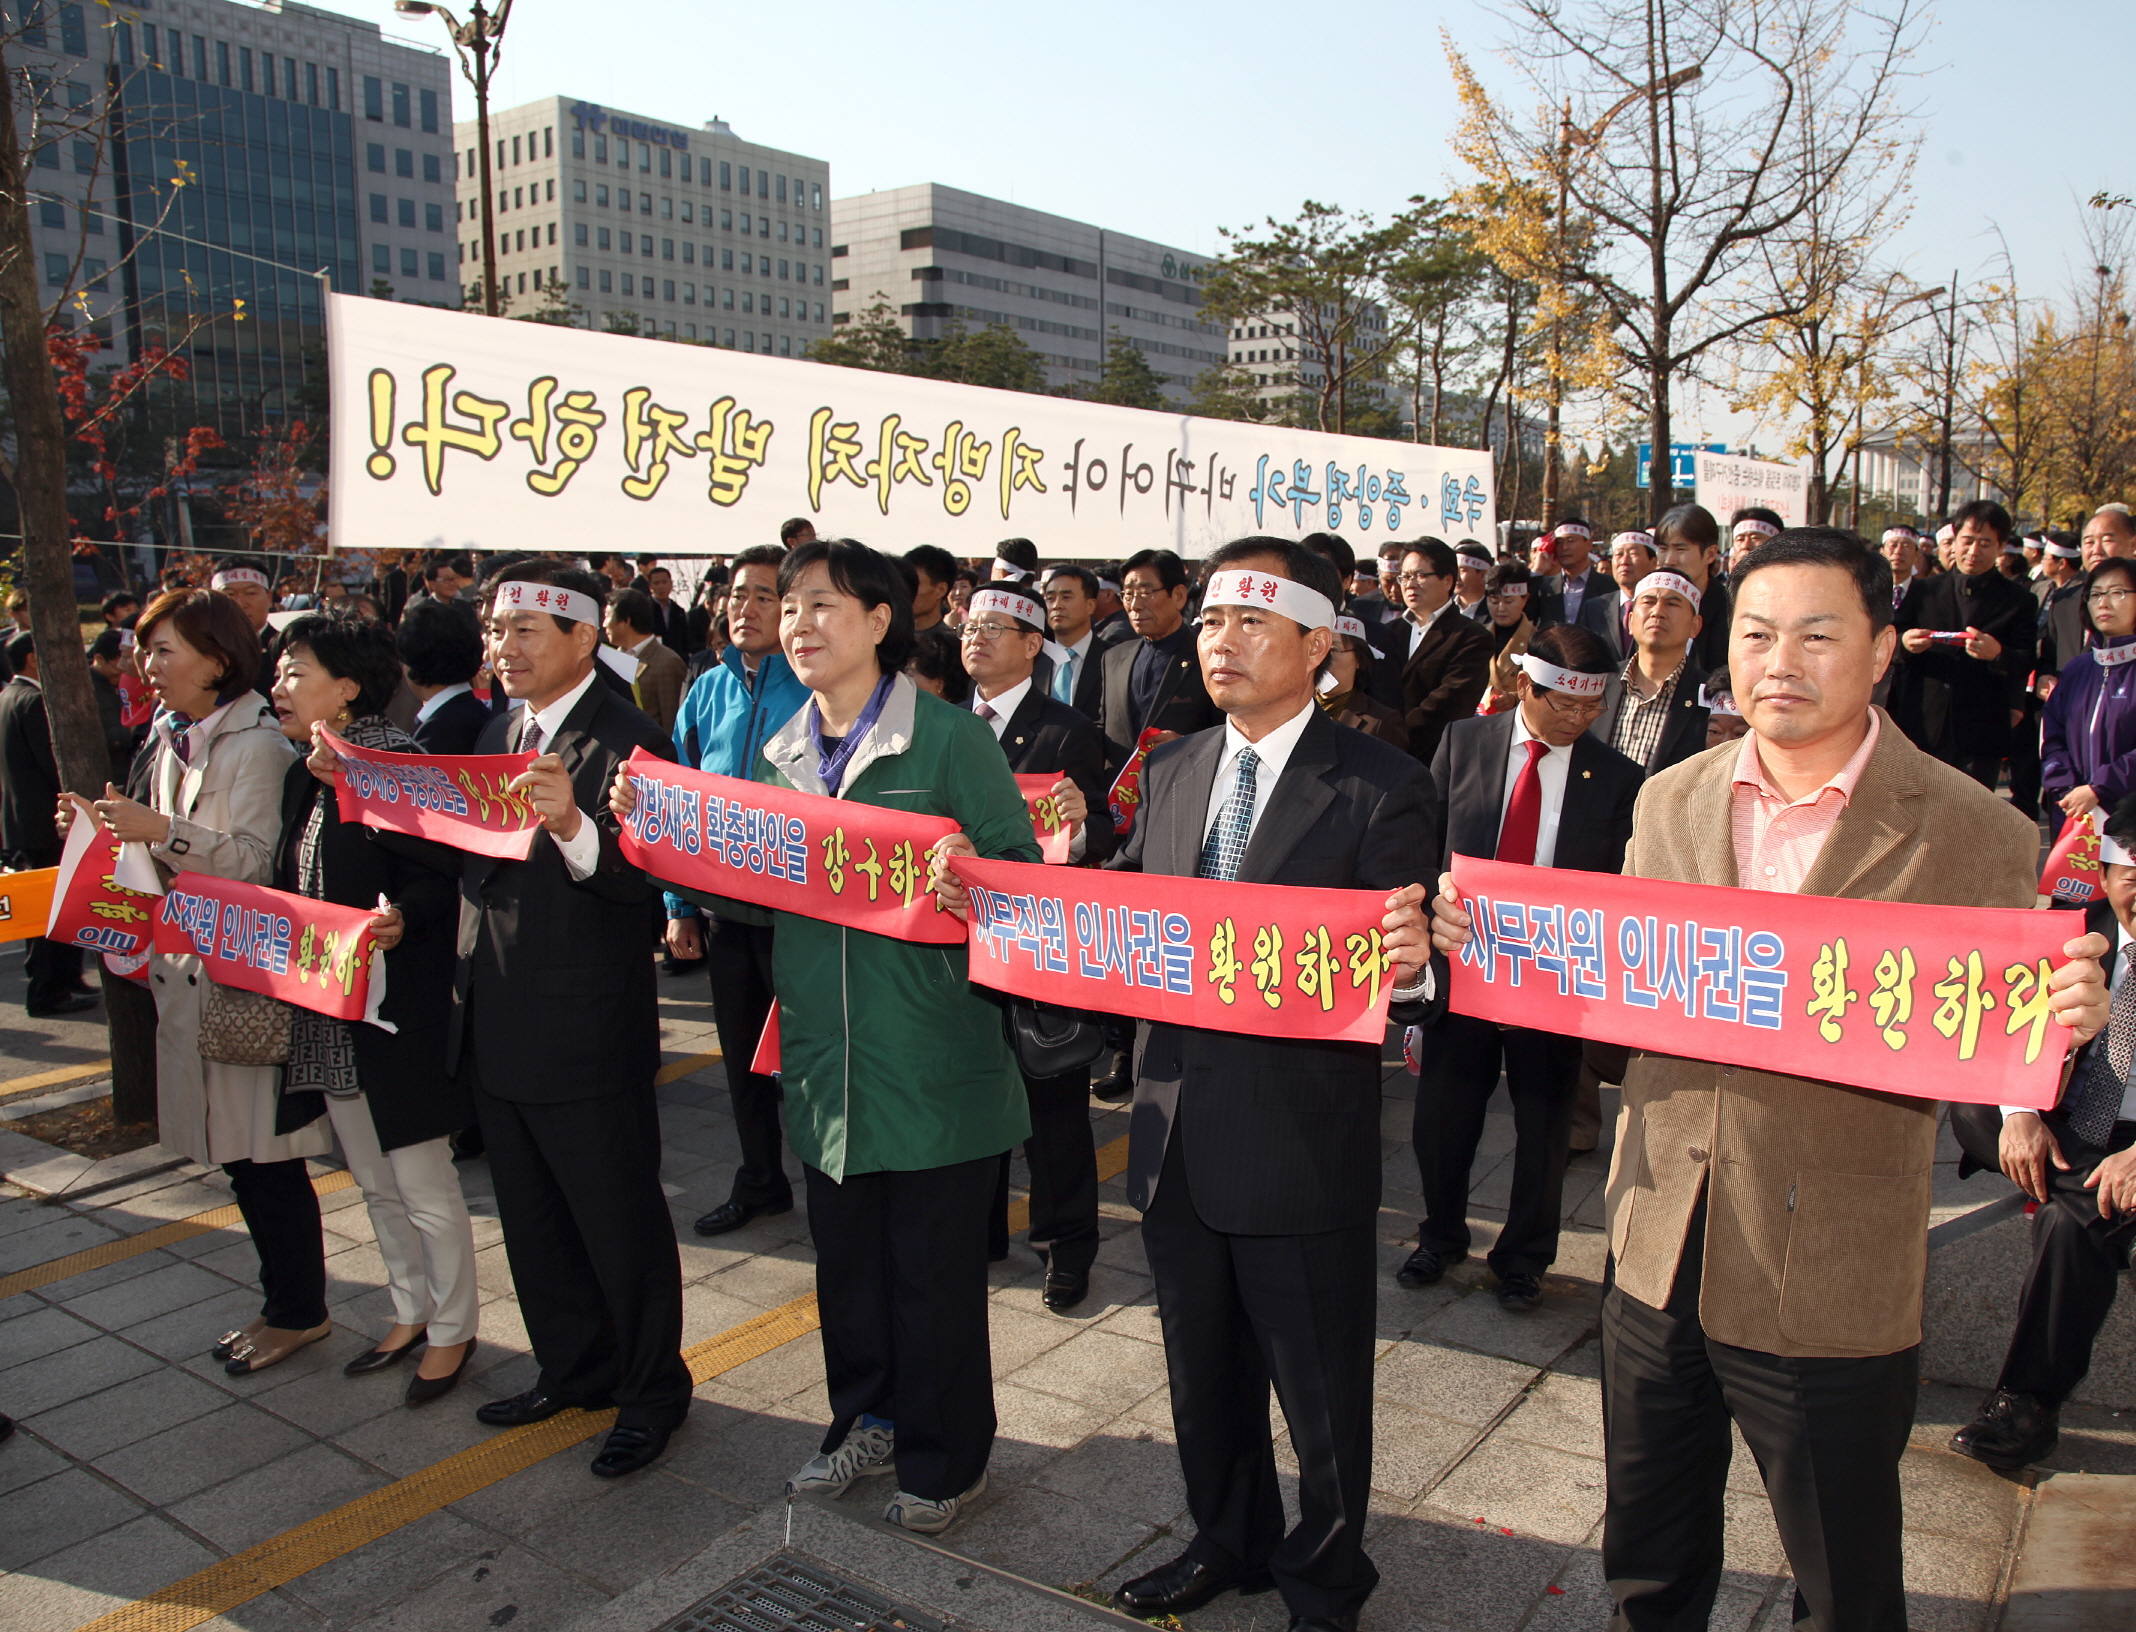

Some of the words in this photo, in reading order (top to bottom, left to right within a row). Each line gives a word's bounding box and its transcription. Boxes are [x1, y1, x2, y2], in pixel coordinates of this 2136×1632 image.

[535, 589, 570, 612] 환원
[1236, 576, 1279, 603] 환원
[706, 795, 808, 885] 확충방안을
[220, 904, 292, 976] 인사권을
[969, 886, 1068, 975] 사무직원
[1074, 901, 1195, 996] 인사권을
[1207, 916, 1391, 1012] 환원하라
[1459, 894, 1606, 1001] 사무직원
[1618, 914, 1788, 1031] 인사권을
[1806, 935, 2056, 1065] 환원하라
